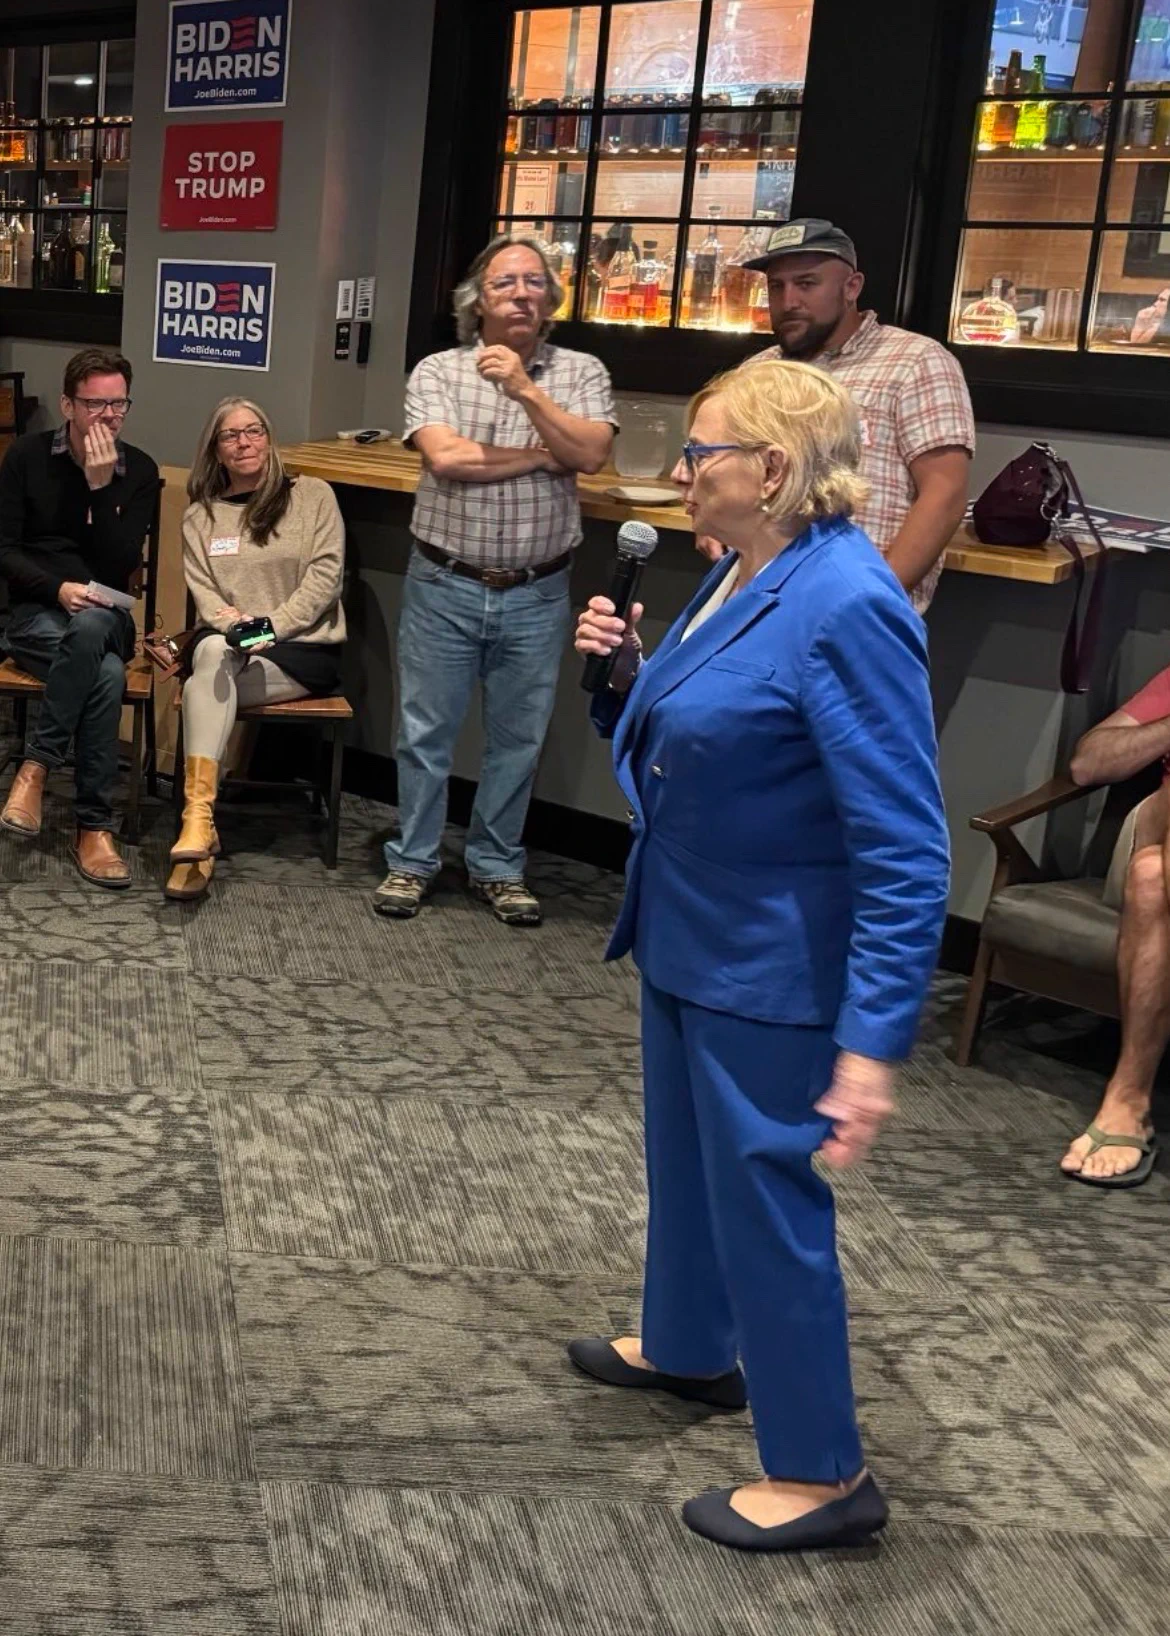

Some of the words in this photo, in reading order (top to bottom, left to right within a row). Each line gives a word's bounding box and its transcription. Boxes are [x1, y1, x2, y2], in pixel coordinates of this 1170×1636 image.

[176, 15, 282, 54] BIDEN
[174, 51, 280, 82] HARRIS
[194, 88, 257, 99] JoeBiden.com
[188, 151, 256, 173] STOP
[175, 177, 265, 198] TRUMP
[164, 280, 265, 315] BIDEN
[162, 312, 263, 343] HARRIS
[180, 344, 241, 357] JoeBiden.com
